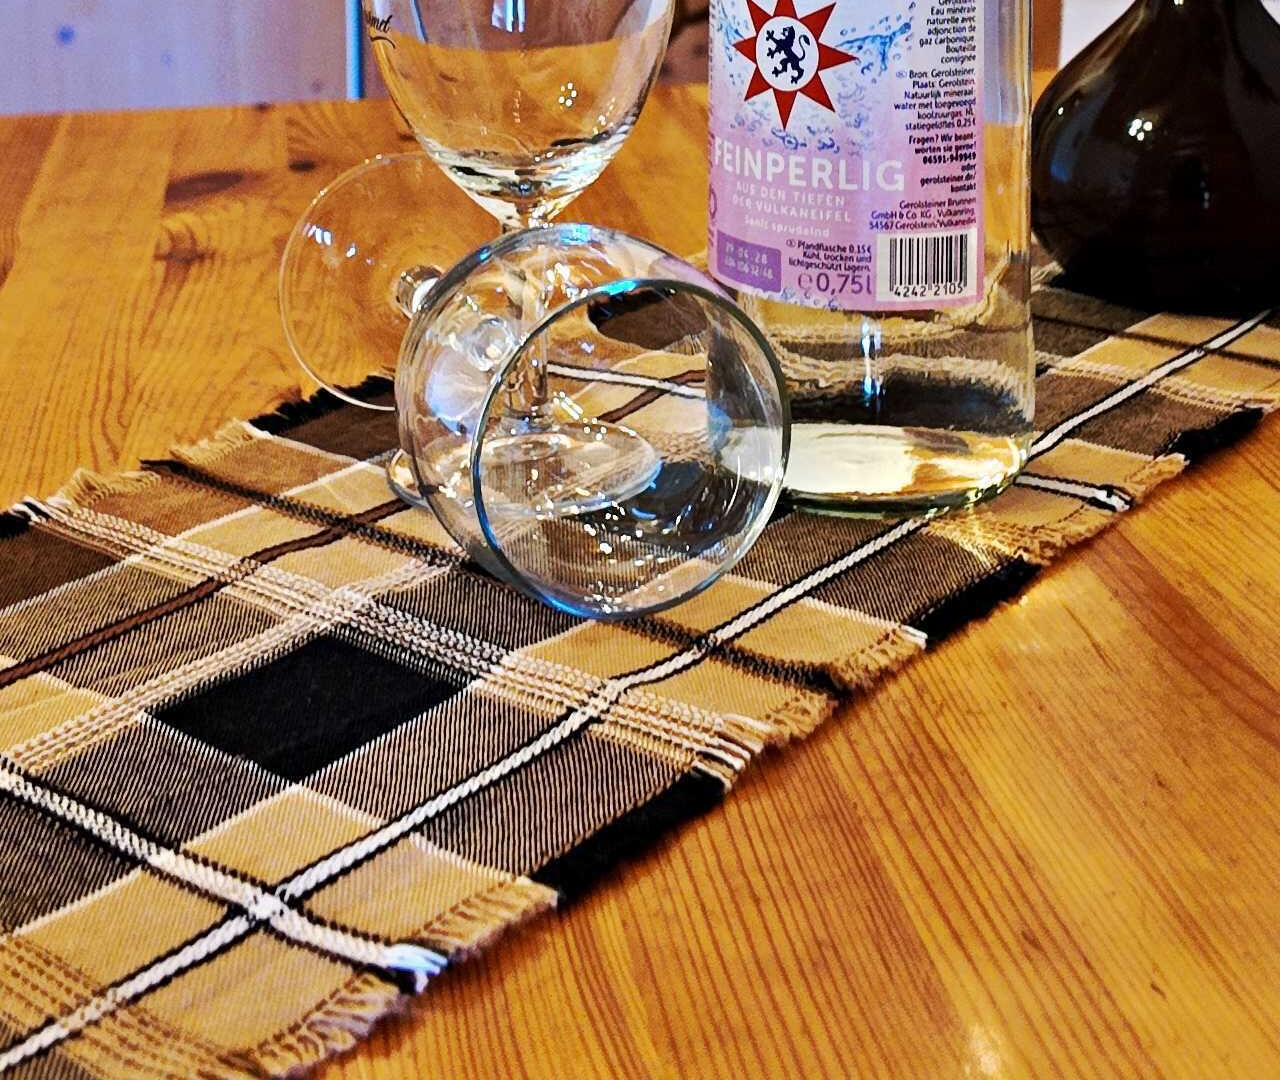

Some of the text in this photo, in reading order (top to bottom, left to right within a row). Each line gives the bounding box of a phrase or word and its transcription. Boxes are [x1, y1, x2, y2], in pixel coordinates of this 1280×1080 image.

[893, 102, 917, 111] water
[918, 100, 933, 110] met
[940, 133, 954, 143] Wir
[793, 190, 846, 208] TIEFEN
[899, 199, 947, 210] Gerolsteiner
[755, 197, 852, 223] VULKANEIFEL
[871, 209, 898, 220] GmbH
[797, 239, 848, 254] Pfandflasche
[823, 251, 855, 263] trocken
[856, 254, 872, 264] und
